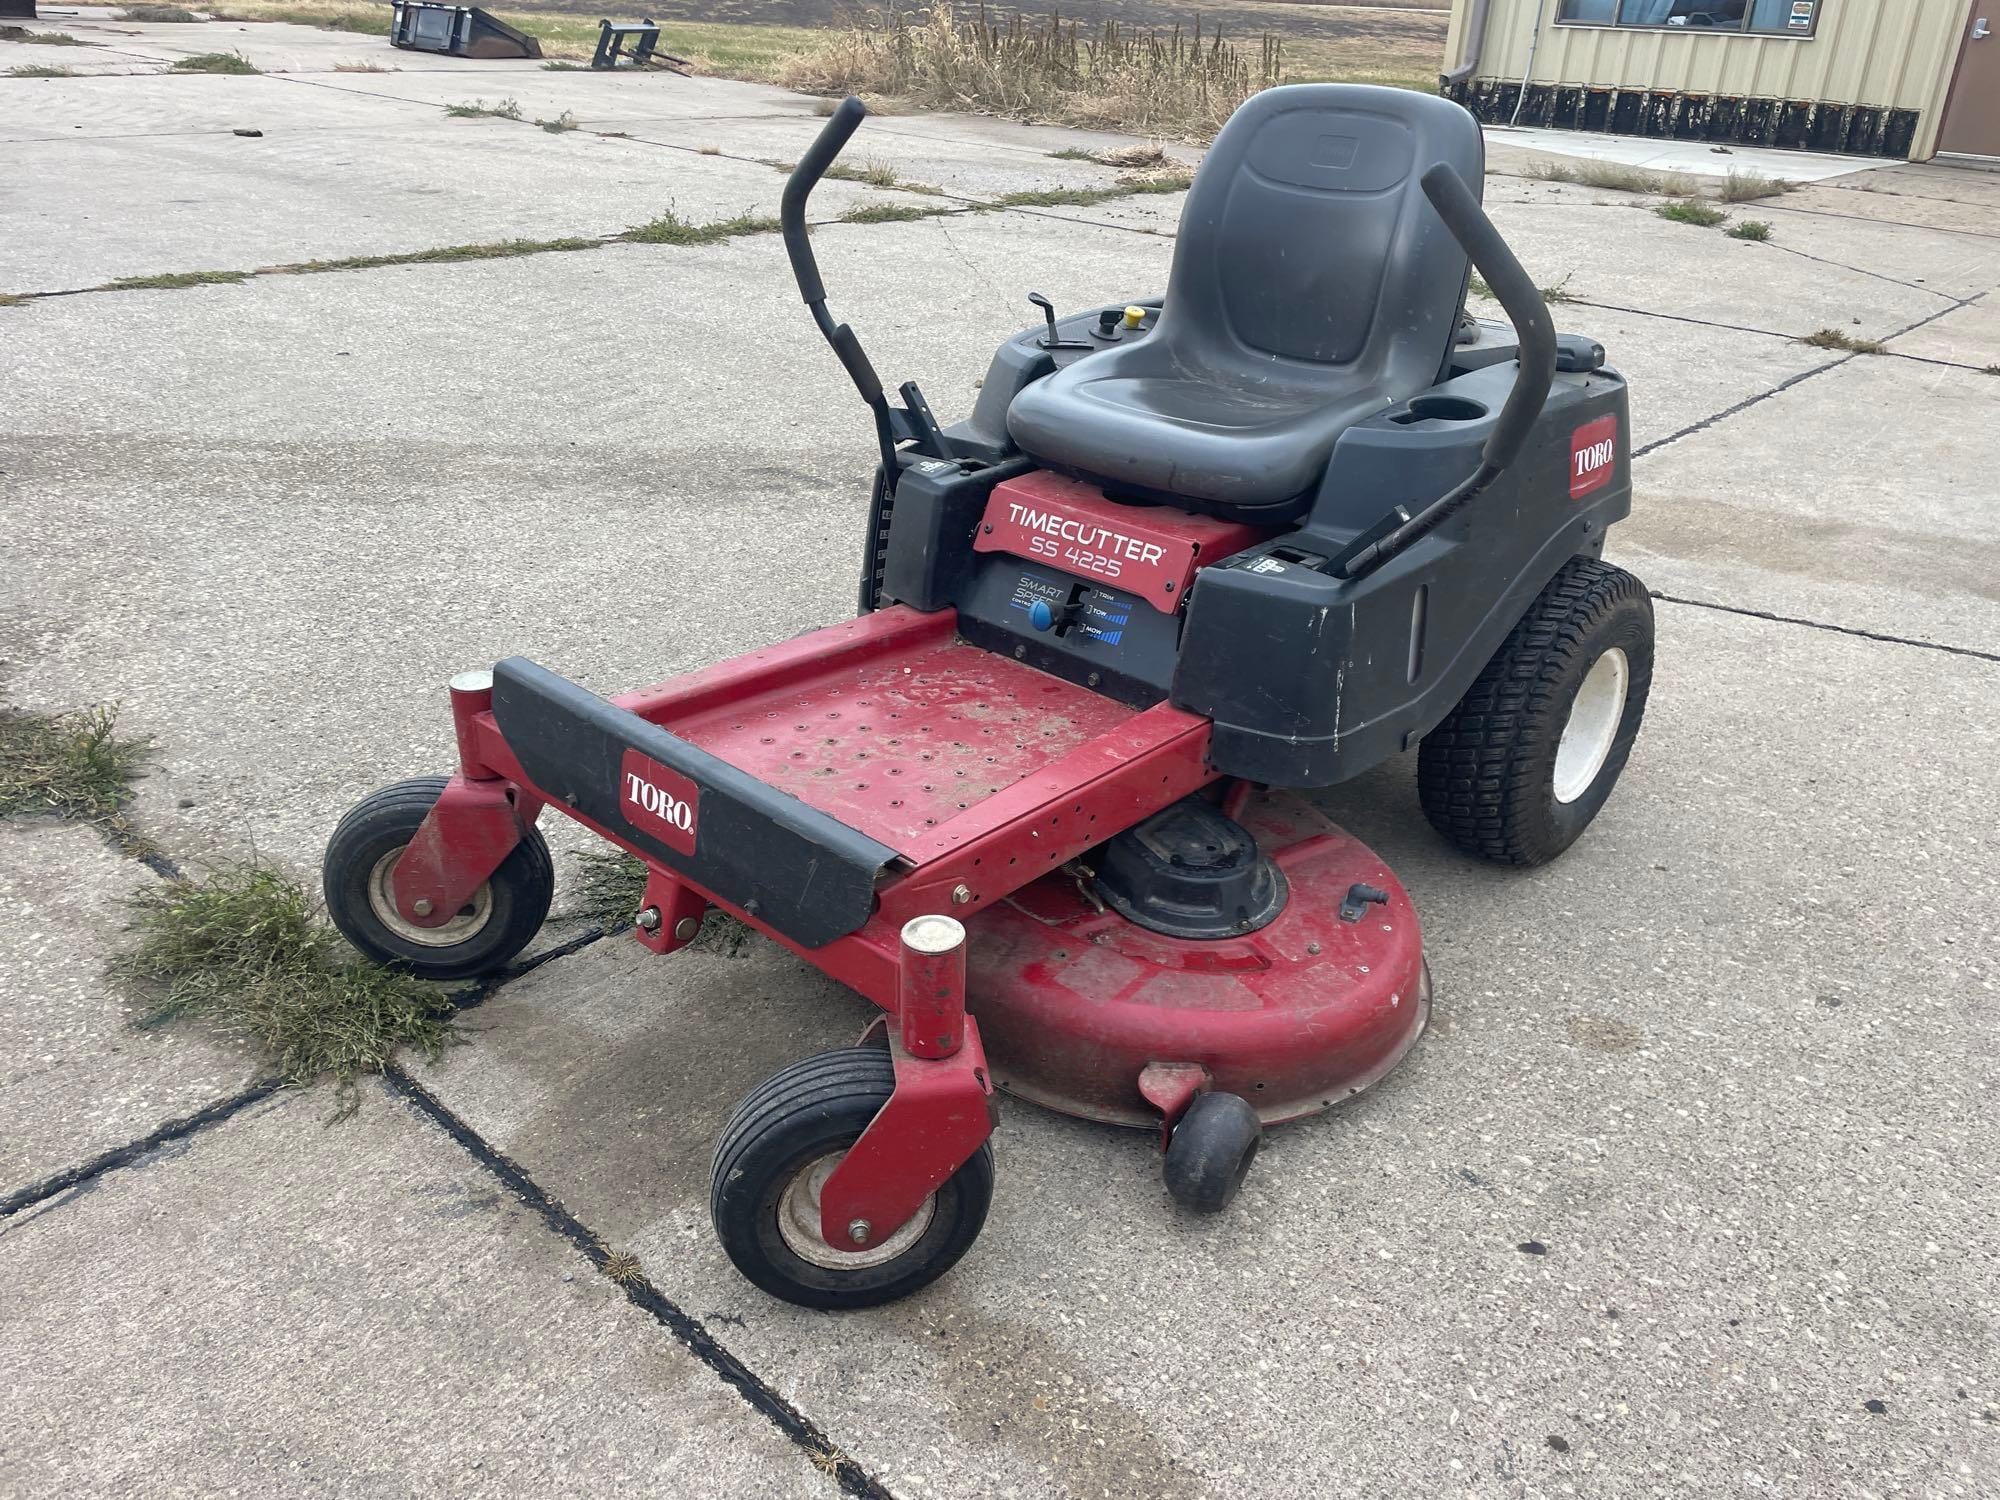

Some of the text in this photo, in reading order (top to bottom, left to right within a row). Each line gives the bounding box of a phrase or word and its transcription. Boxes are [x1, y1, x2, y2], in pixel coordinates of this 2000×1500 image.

[1575, 438, 1613, 476] TORO
[1009, 502, 1163, 567] TIMECUTTER
[1029, 536, 1123, 578] SS 4225
[1014, 587, 1054, 602] SPEE
[1018, 577, 1064, 598] SMART
[1099, 591, 1114, 601] TRIM
[1093, 607, 1107, 617] TOW
[1086, 626, 1103, 635] MOW
[626, 772, 692, 831] TORO
